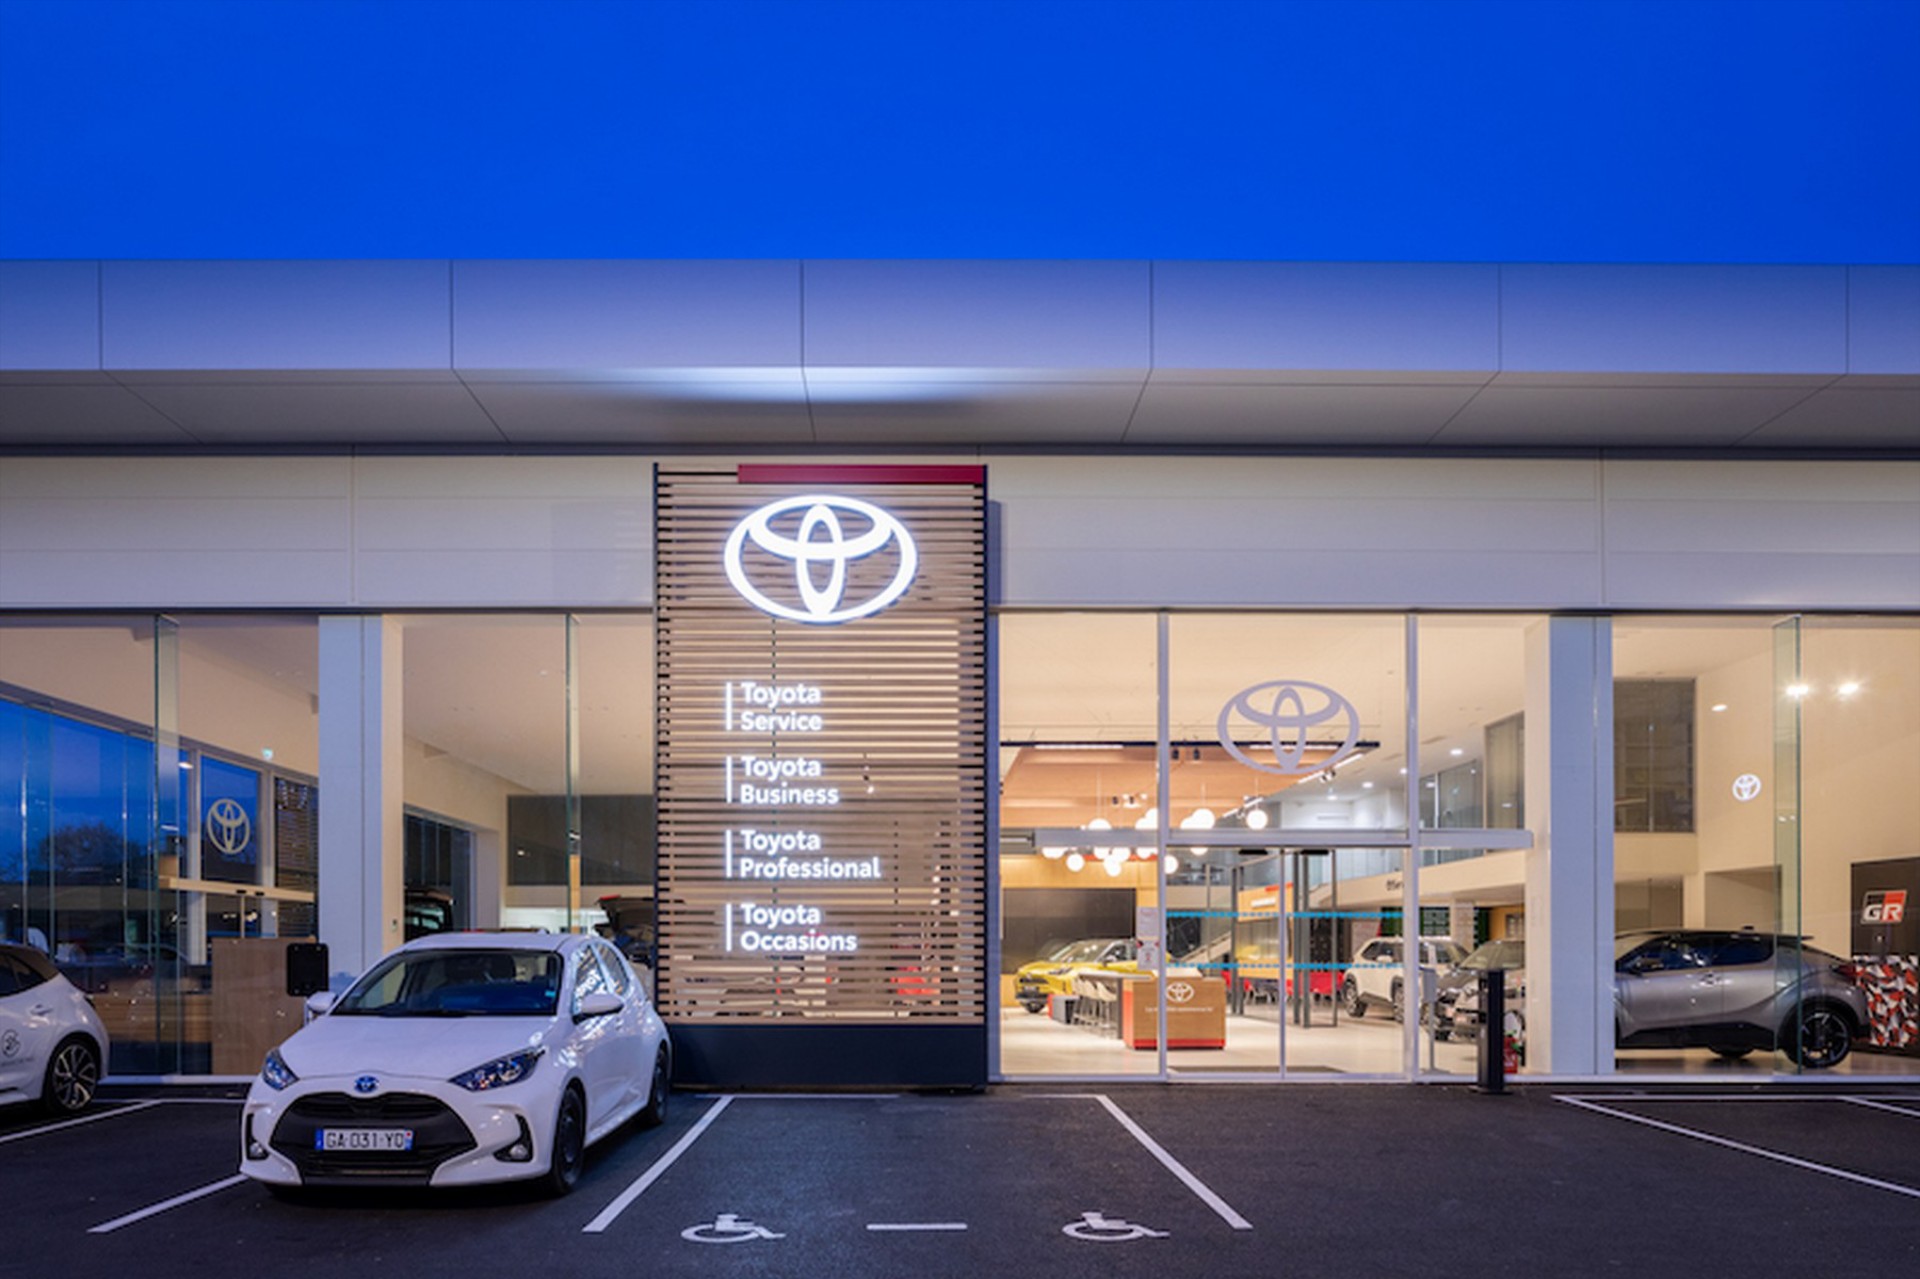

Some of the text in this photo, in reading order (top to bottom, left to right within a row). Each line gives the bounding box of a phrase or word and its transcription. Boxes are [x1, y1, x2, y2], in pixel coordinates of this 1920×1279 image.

[741, 682, 821, 707] Toyota
[741, 710, 822, 731] Service
[741, 756, 821, 782] Toyota
[741, 781, 839, 803] Business
[741, 829, 821, 855] Toyota
[740, 857, 881, 878] Professional
[741, 903, 821, 929] Toyota
[1862, 903, 1902, 922] GR
[741, 930, 858, 951] Occasions
